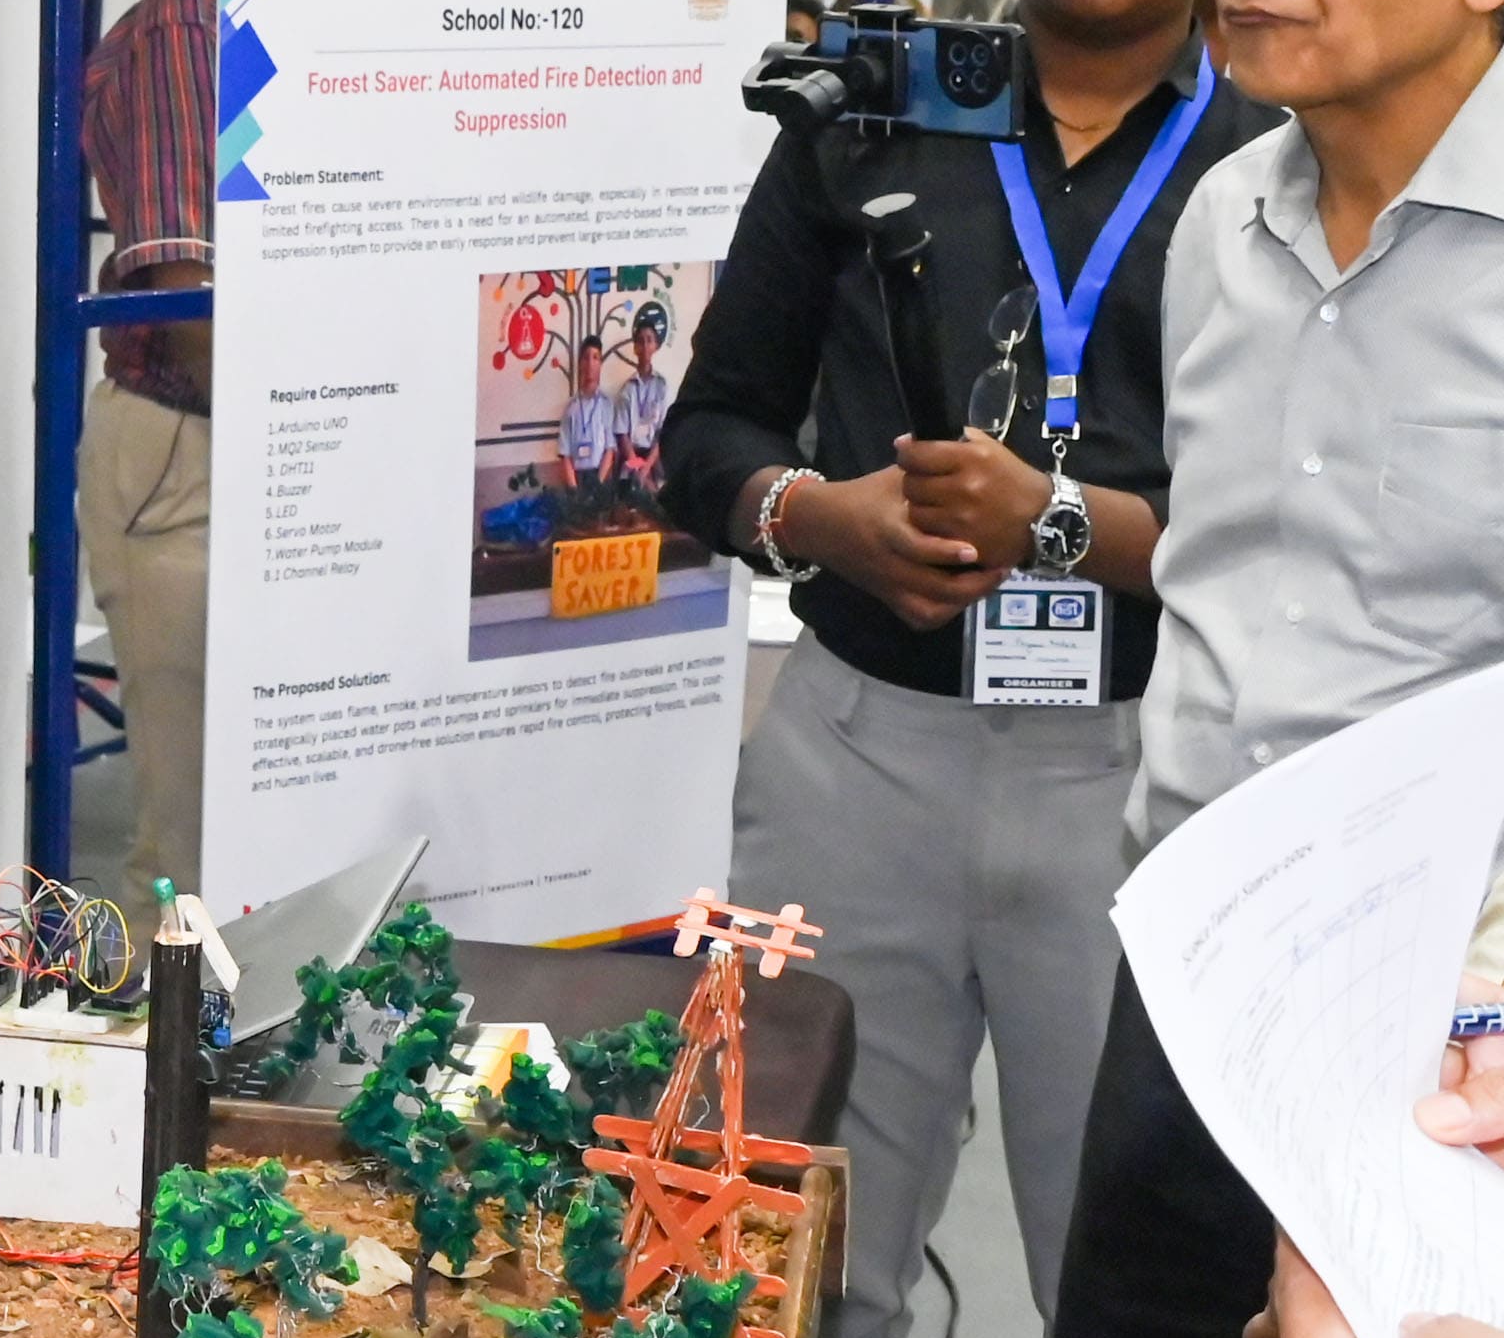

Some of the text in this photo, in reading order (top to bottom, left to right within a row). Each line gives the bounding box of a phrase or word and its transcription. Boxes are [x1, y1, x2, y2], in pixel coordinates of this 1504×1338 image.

[442, 7, 584, 31] School No:-120
[308, 63, 703, 95] Forest Saver: Automated Fire Detection and
[454, 107, 567, 137] Suppression
[263, 169, 385, 186] Problem Statement:
[262, 203, 297, 217] Forest
[302, 201, 326, 214] fires
[331, 201, 362, 213] cause
[368, 200, 402, 211] severe
[408, 194, 482, 209] environmental
[487, 192, 506, 206] and
[512, 190, 547, 204] wildlife
[599, 187, 646, 202] especially
[652, 185, 661, 196] in
[666, 184, 699, 197] remote
[262, 224, 299, 238] limited
[305, 221, 363, 238] firefighting
[410, 217, 439, 230] There
[444, 217, 453, 229] is
[457, 218, 464, 228] a
[468, 215, 494, 227] need
[498, 213, 512, 226] for
[517, 213, 530, 225] an
[667, 205, 682, 216] fire
[262, 244, 326, 260] suppression
[329, 242, 367, 258] system
[370, 241, 380, 253] to
[383, 238, 422, 254] provide
[426, 240, 438, 251] an
[468, 235, 514, 249] response
[517, 233, 535, 246] and
[537, 231, 575, 246] prevent
[270, 382, 400, 405] Require Components:
[323, 416, 348, 430] UNO
[305, 439, 342, 454] Sensor
[279, 462, 315, 476] DHT11
[309, 522, 341, 535] Motor
[310, 542, 341, 557] Pump
[344, 538, 383, 552] Module
[557, 538, 652, 579] FOREST
[282, 564, 327, 580] Channel
[330, 562, 361, 577] Relay
[252, 672, 392, 700] The Proposed Solution:
[254, 716, 273, 730] The
[277, 713, 315, 729] system
[319, 710, 343, 723] uses
[422, 694, 442, 708] and
[445, 687, 508, 706] temperature
[511, 681, 549, 697] sensors
[552, 679, 563, 691] to
[566, 674, 597, 690] detect
[600, 670, 616, 683] fire
[619, 666, 663, 681] outbreaks
[667, 660, 684, 673] and
[1003, 679, 1073, 689] ORGANISER
[253, 731, 318, 752] strategically
[321, 726, 357, 743] placed
[361, 722, 390, 736] water
[393, 719, 416, 733] pots
[420, 715, 441, 728] with
[445, 710, 479, 726] pumps
[482, 705, 500, 719] and
[504, 699, 552, 717] sprinklers
[554, 697, 568, 710] for
[572, 690, 620, 706] immediate
[252, 753, 302, 772] effective,
[305, 748, 352, 765] scalable,
[354, 744, 374, 758] and
[377, 736, 432, 755] drone-free
[434, 730, 476, 747] solution
[478, 724, 517, 740] ensures
[520, 719, 544, 735] rapid
[547, 716, 564, 729] fire
[605, 705, 652, 723] protecting
[251, 778, 272, 793] and
[274, 773, 310, 788] human
